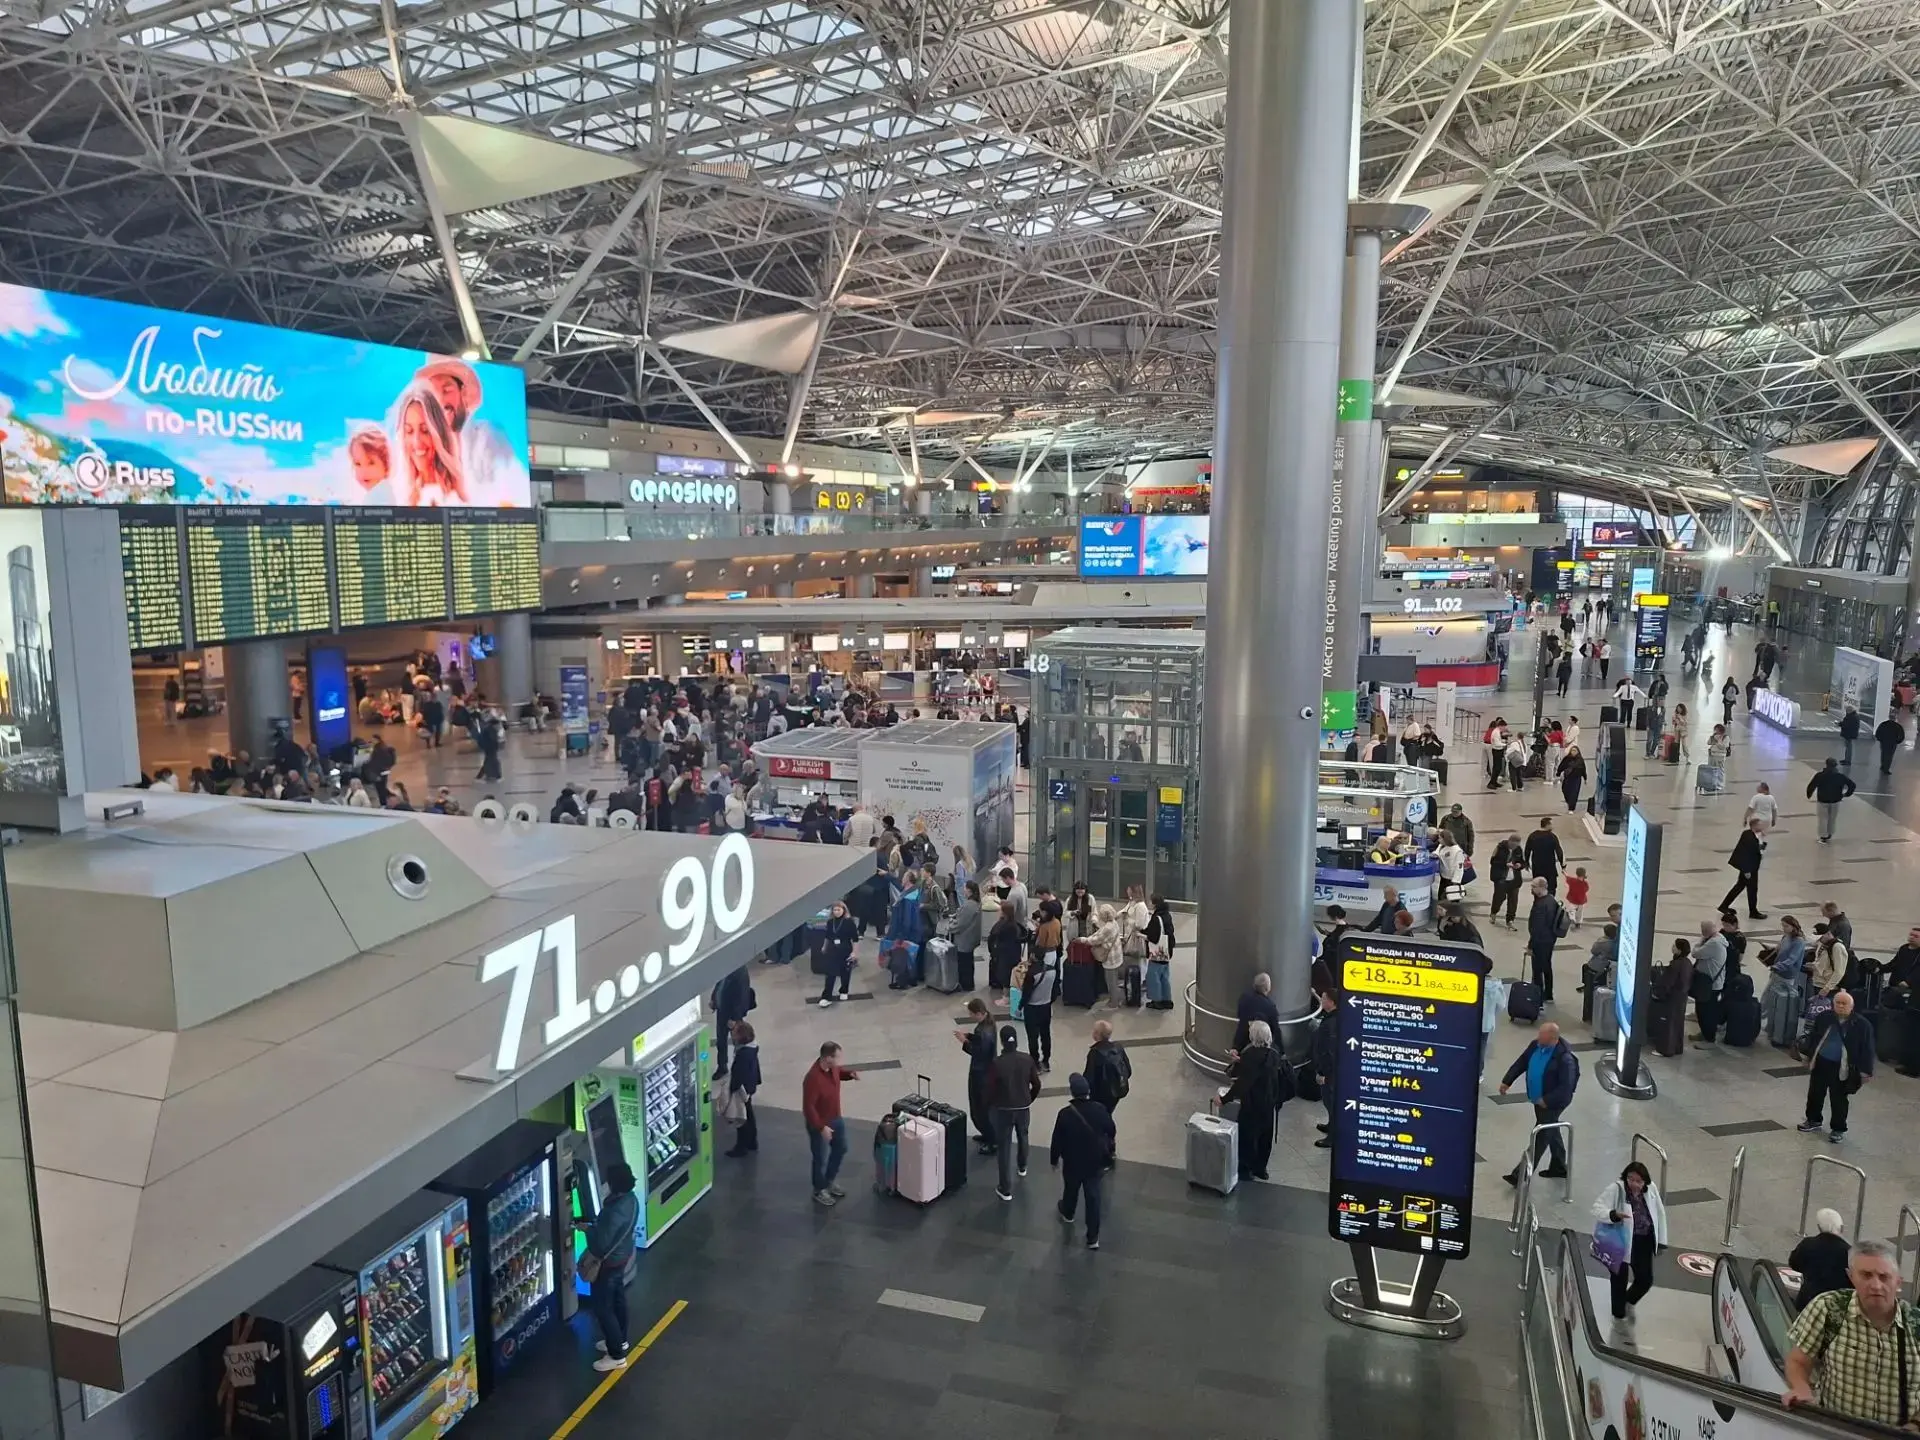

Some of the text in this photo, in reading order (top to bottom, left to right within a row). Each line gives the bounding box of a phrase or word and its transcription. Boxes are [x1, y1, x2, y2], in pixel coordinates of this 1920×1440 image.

[65, 325, 284, 403] Любить
[146, 409, 304, 442] по-RUSSки
[115, 463, 176, 488] Russ
[629, 479, 737, 511] aerosleep
[1332, 480, 1343, 512] point
[1329, 519, 1343, 571] Meeting
[1326, 580, 1337, 632] встречи
[1404, 597, 1463, 613] 91...102
[1323, 637, 1334, 678] Место
[791, 759, 824, 768] TURKISH
[791, 766, 825, 775] AIRLINES
[1055, 782, 1064, 795] 2
[480, 831, 755, 1071] 71...90
[1366, 946, 1402, 956] Выходы
[1418, 952, 1457, 964] посадку
[1366, 955, 1394, 964] Boarding
[1365, 967, 1422, 987] 18...31
[1362, 1008, 1394, 1018] стойки
[1363, 999, 1424, 1013] Регистрация,
[1361, 1042, 1422, 1056] Регистрация,
[1361, 1050, 1393, 1060] стойки
[1360, 1076, 1391, 1087] Туалет
[1359, 1103, 1410, 1116] Бизнес-зал
[1358, 1129, 1396, 1141] ВИП-зал
[1357, 1149, 1423, 1165] Зал ожидания
[517, 1306, 550, 1349] pepsi
